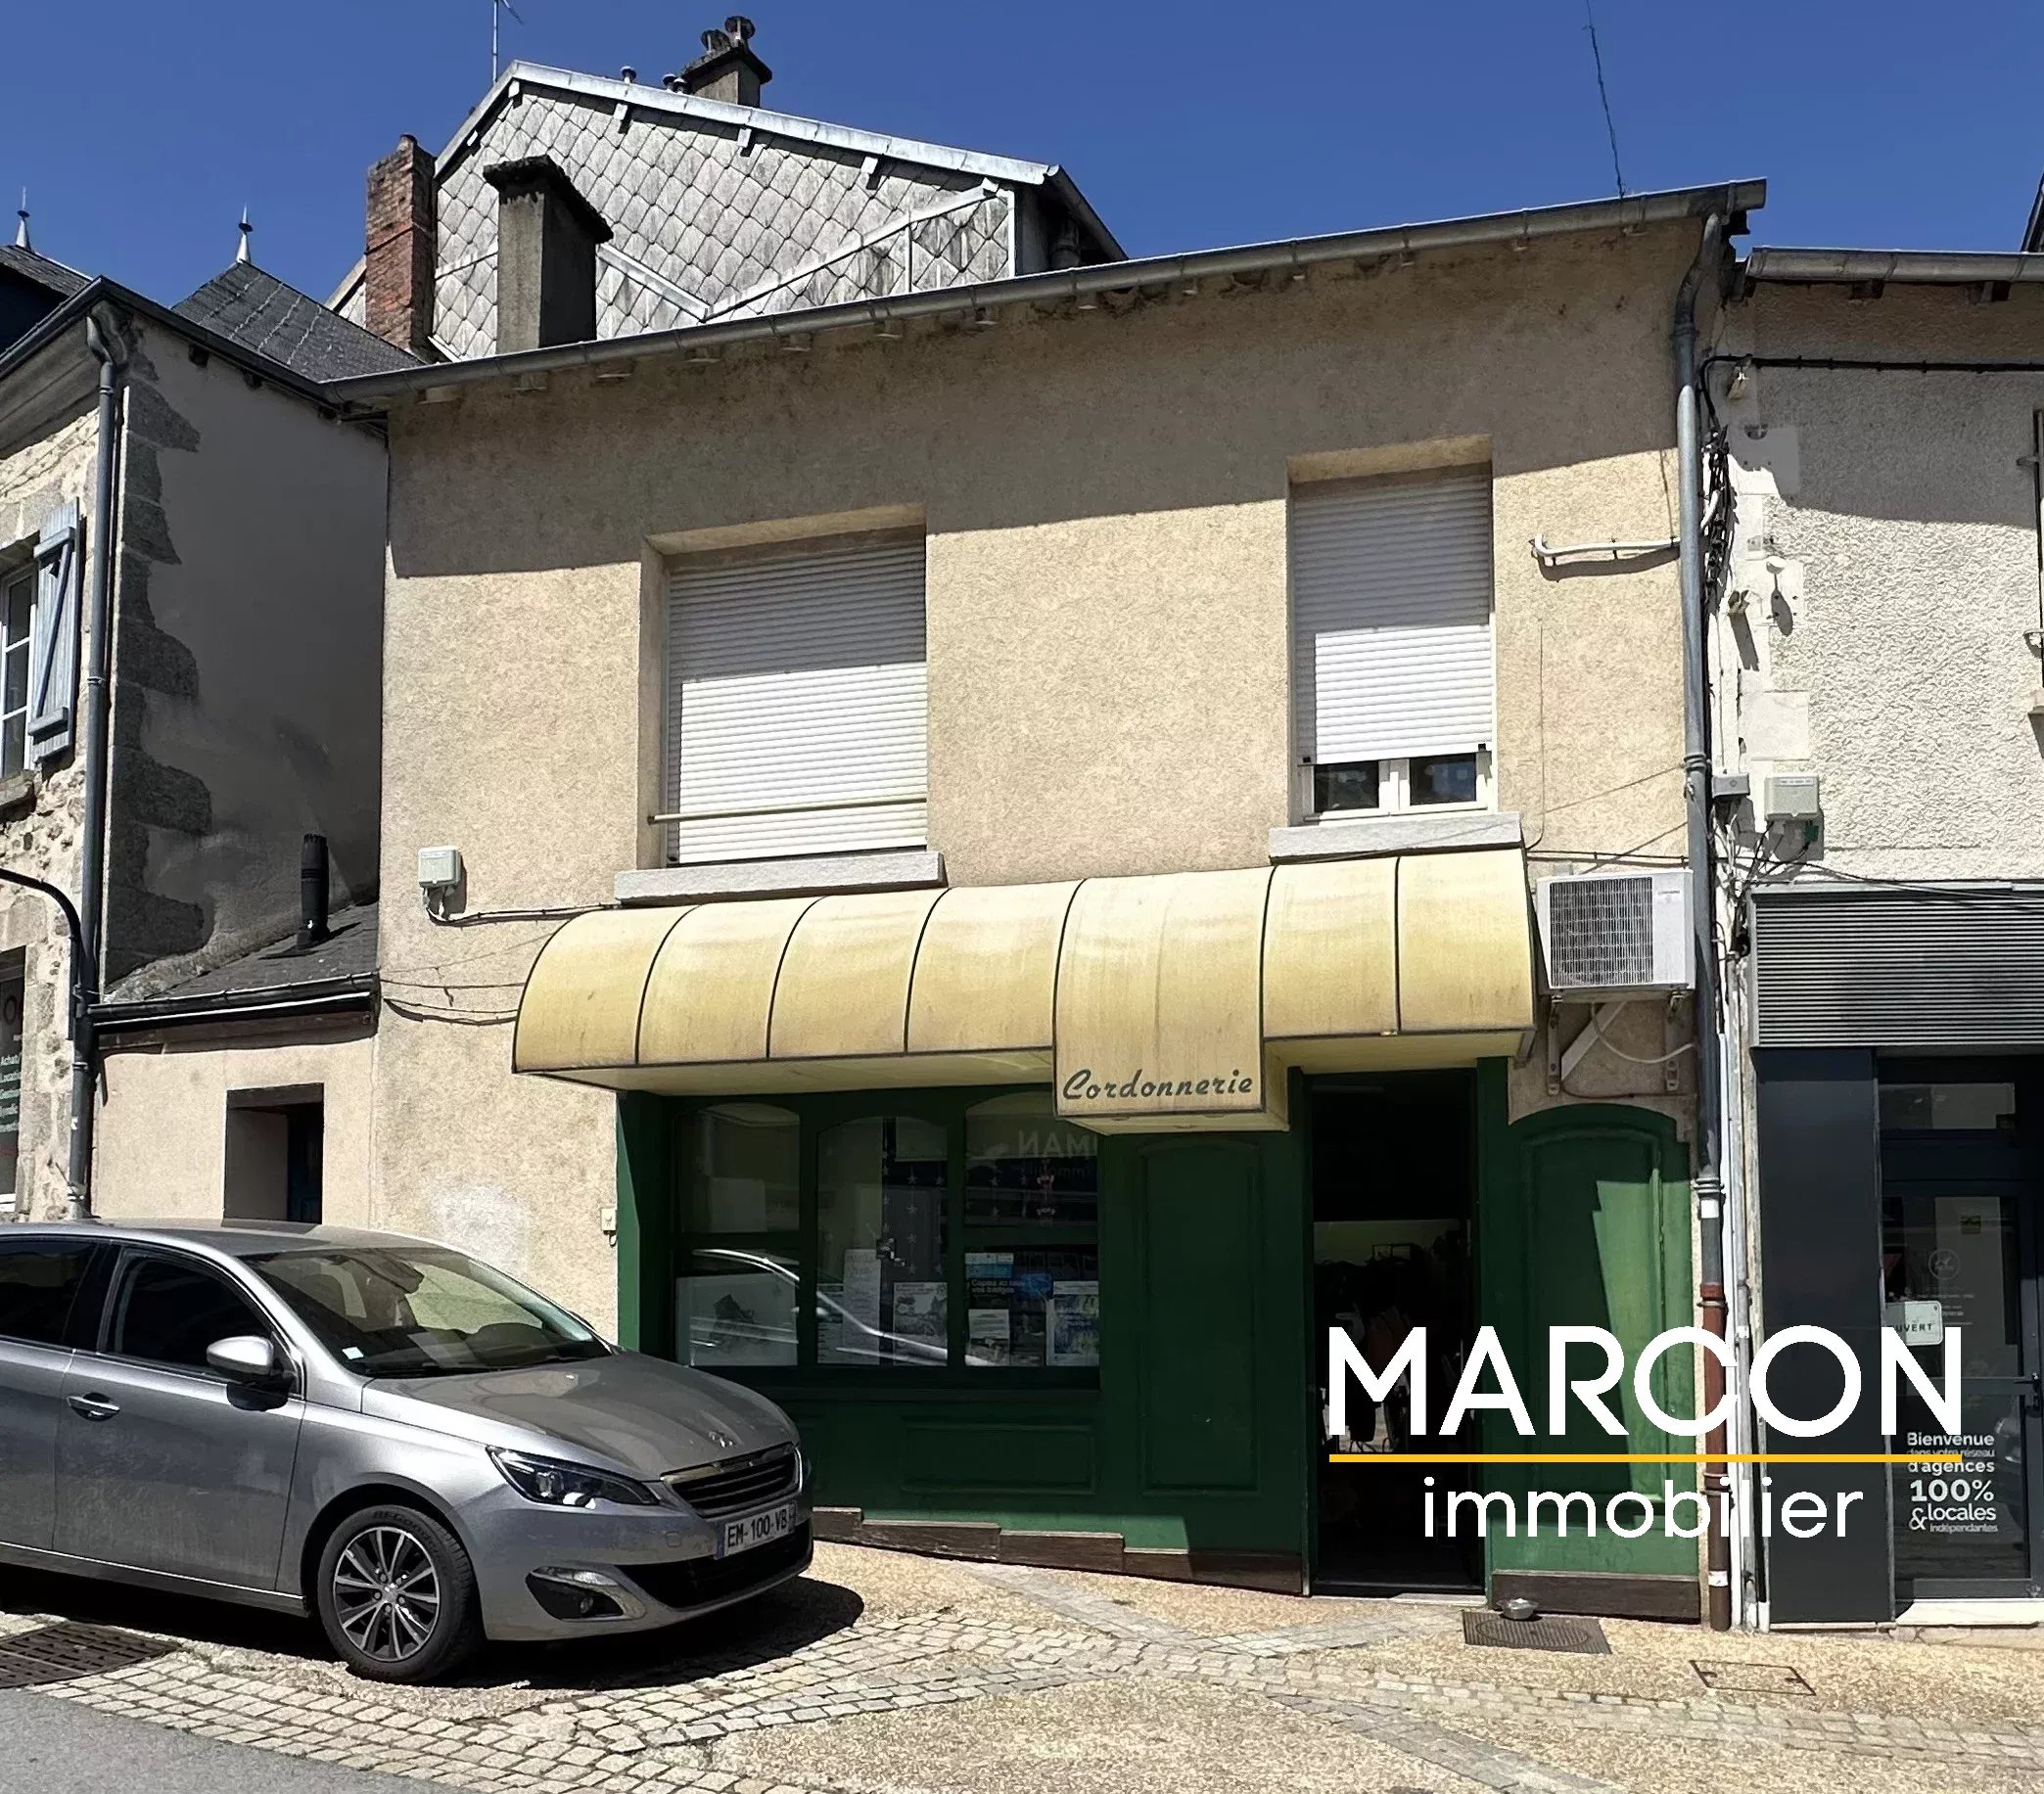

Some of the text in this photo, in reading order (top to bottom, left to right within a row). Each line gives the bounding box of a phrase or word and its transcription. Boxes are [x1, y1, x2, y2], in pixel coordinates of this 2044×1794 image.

[1063, 1069, 1253, 1100] Cordonnerie
[1894, 1322, 1932, 1332] UVERT
[1907, 1432, 1995, 1447] Bienvenue
[1910, 1479, 1995, 1502] 100%
[1908, 1502, 1997, 1531] & locales
